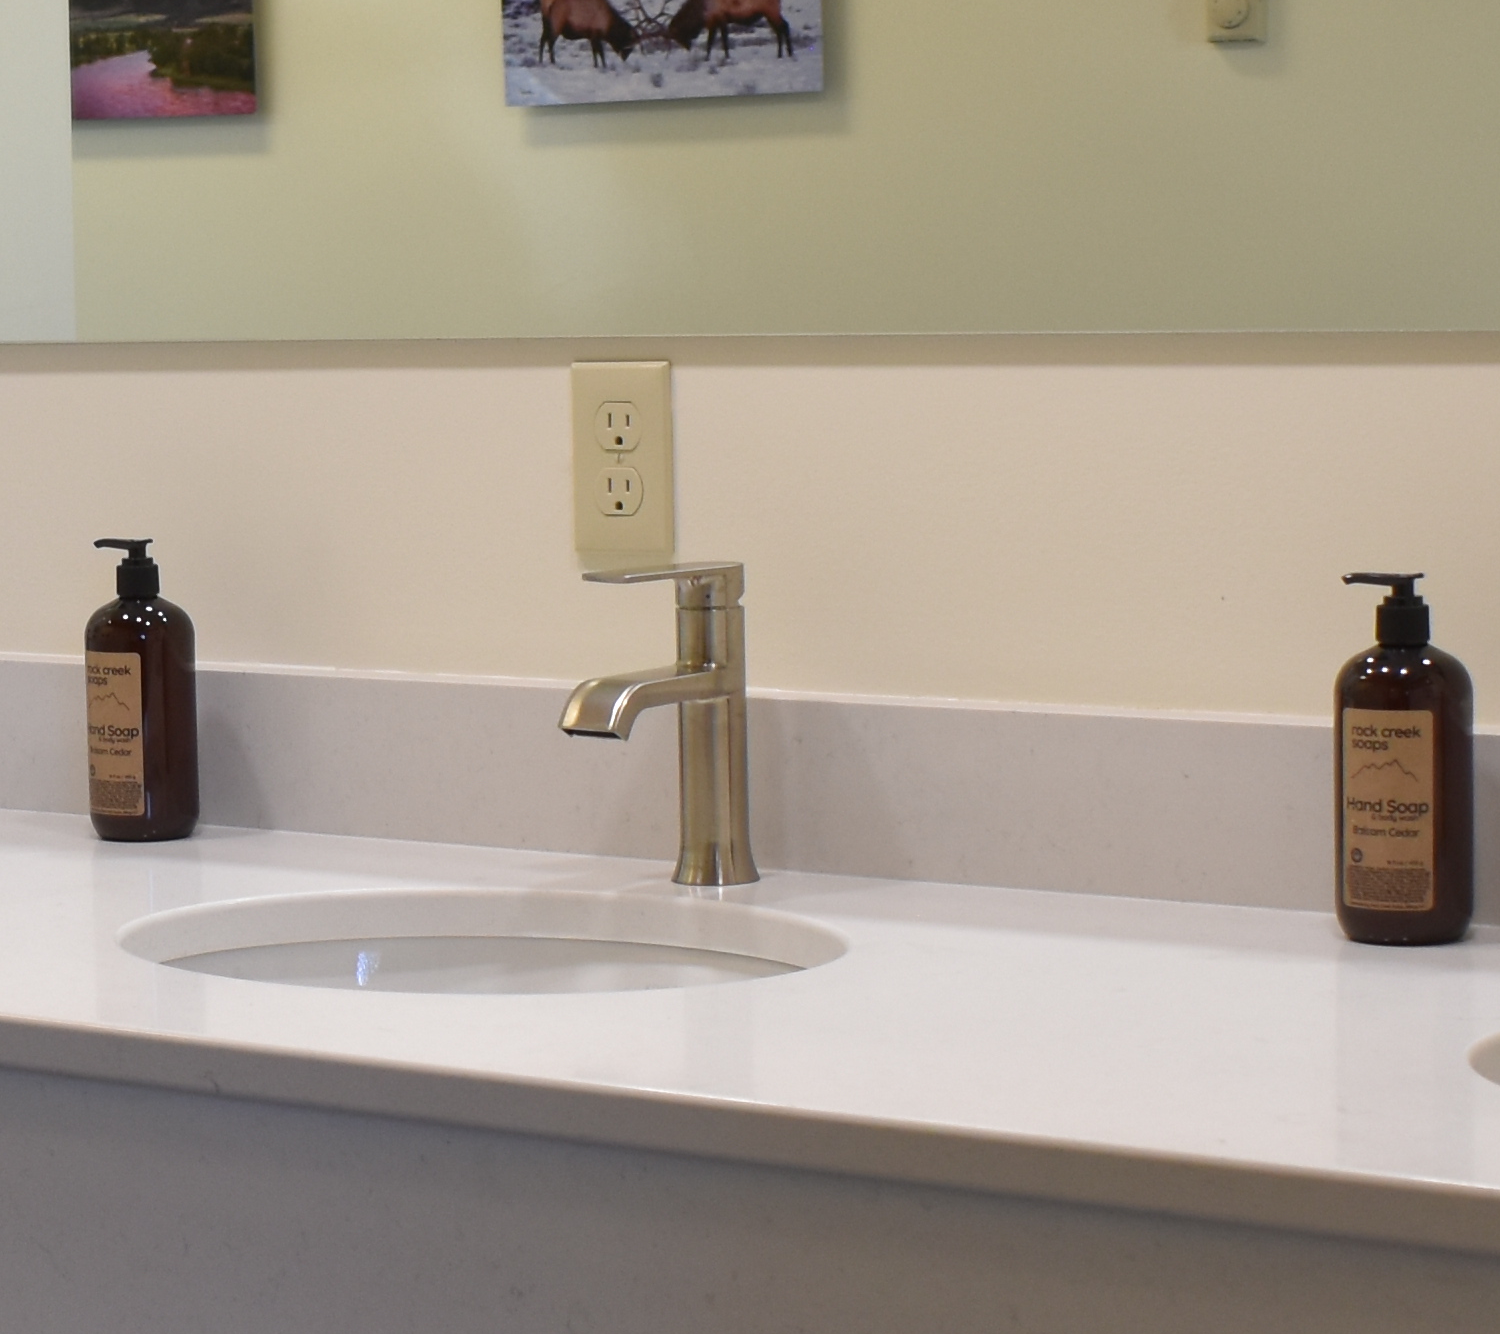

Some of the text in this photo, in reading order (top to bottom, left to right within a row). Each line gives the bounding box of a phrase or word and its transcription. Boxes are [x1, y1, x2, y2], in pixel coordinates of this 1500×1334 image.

[102, 665, 132, 676] creek
[107, 724, 140, 740] Soap
[1351, 725, 1421, 739] rock creek
[1351, 738, 1388, 752] soaps
[1346, 796, 1430, 816] Hand Soap
[1387, 827, 1420, 838] Cedar
